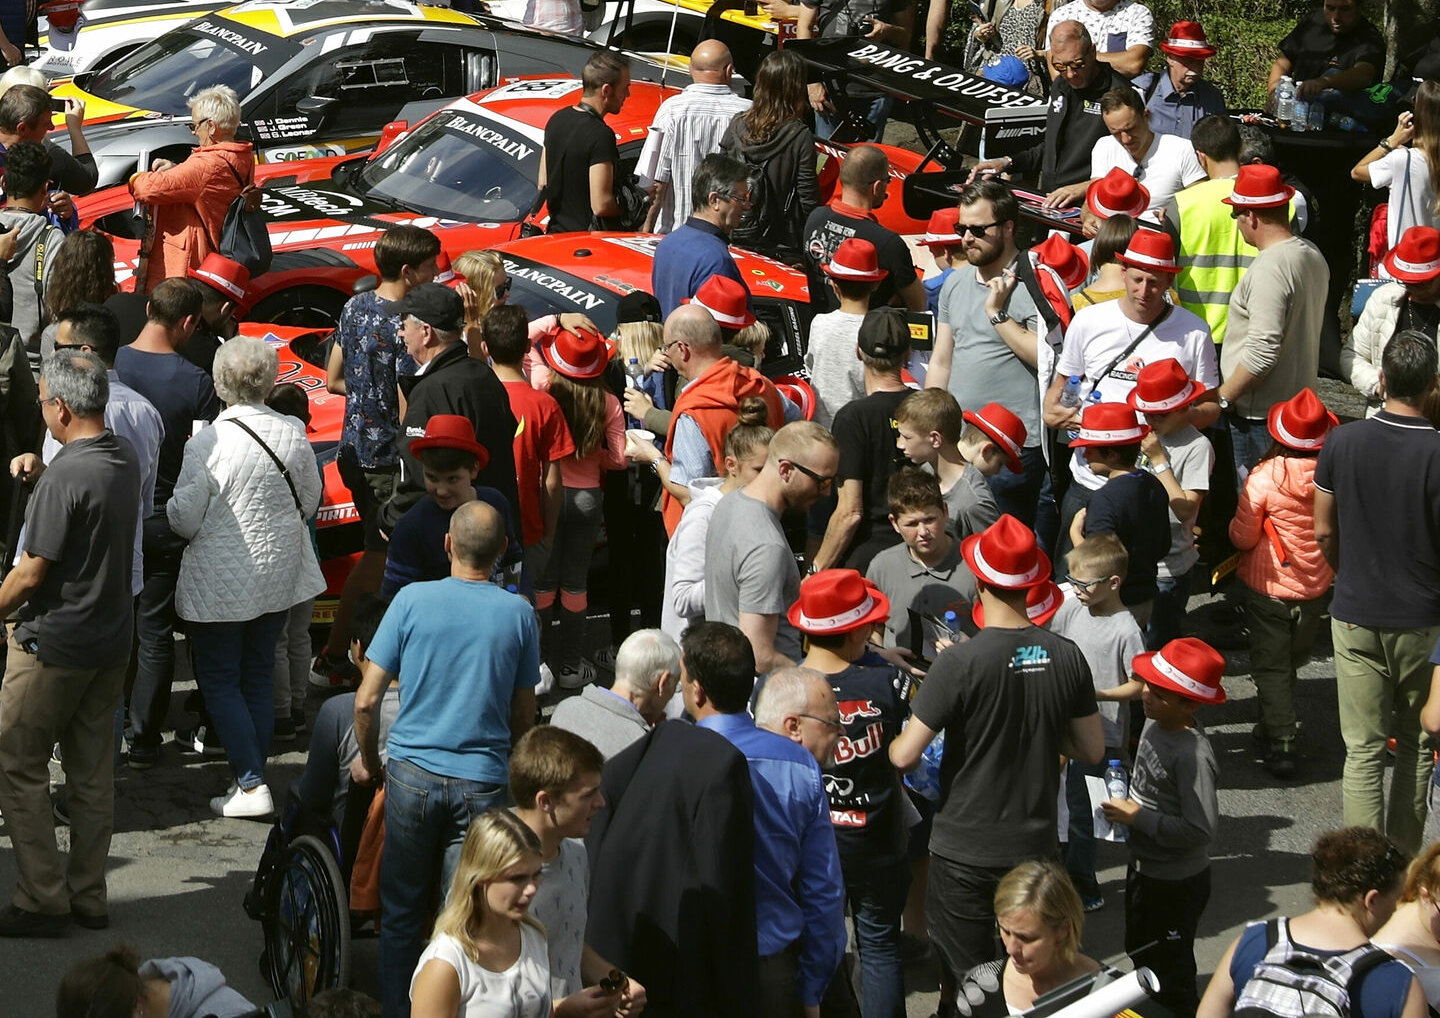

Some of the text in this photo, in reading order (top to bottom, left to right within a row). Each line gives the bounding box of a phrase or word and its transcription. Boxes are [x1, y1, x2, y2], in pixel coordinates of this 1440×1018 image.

[192, 20, 269, 56] BLANCPAIN
[847, 43, 910, 74] BANG
[911, 65, 938, 84] &
[936, 70, 1049, 111] OLUFSEN
[447, 115, 534, 162] BLANCPAIN
[834, 721, 884, 765] Bull
